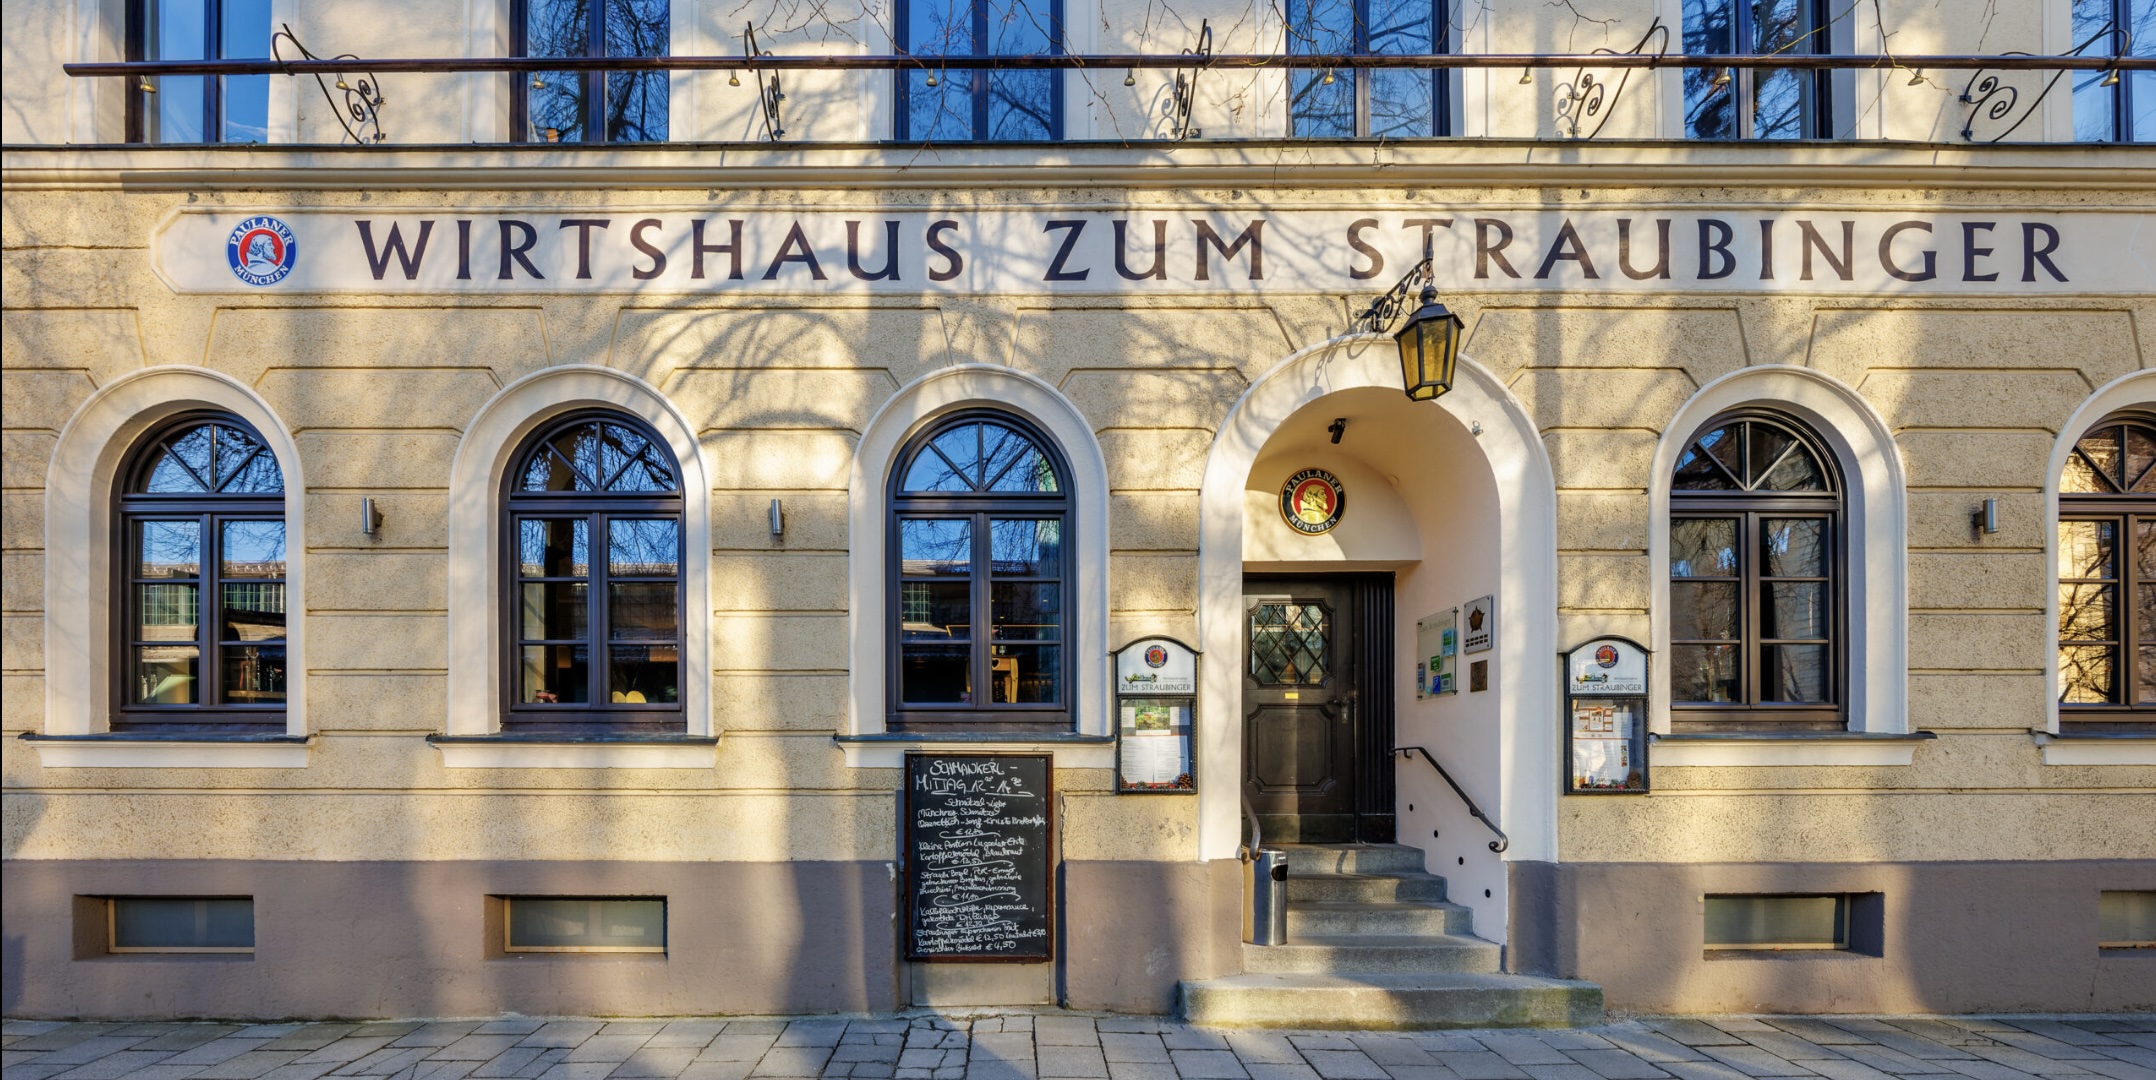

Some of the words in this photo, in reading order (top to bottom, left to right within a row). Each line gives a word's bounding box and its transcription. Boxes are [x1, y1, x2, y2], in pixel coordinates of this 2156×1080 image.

[230, 218, 294, 247] PAULANER
[354, 219, 964, 281] WIRTSHAUS
[1043, 219, 1267, 281] ZUM
[1346, 218, 2070, 282] STRAUBINGER
[234, 264, 289, 285] MÜNCHEN
[1286, 470, 1343, 494] PAULANER
[1141, 683, 1191, 691] STRAUBINGER
[1592, 683, 1642, 691] STRAUBINGER
[930, 761, 1005, 776] SCHMANKERL
[917, 774, 966, 794] MITTAG
